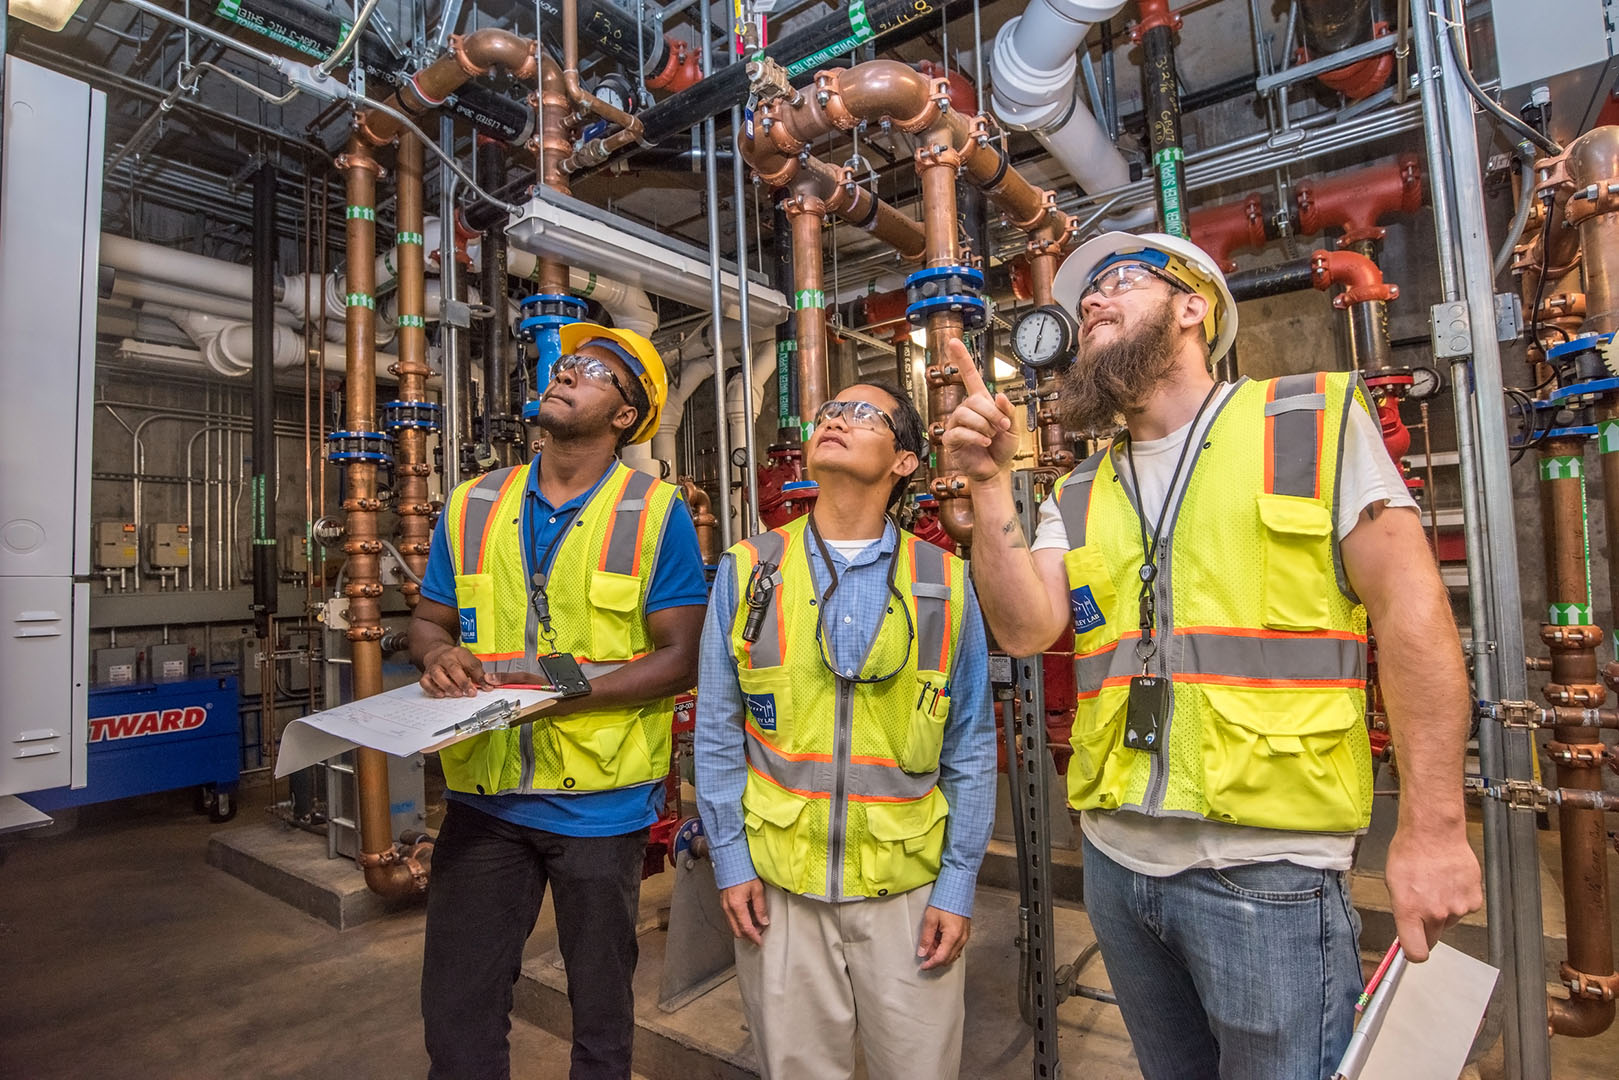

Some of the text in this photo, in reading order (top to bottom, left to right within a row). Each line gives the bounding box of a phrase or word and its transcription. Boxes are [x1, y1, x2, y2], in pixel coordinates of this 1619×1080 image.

[235, 16, 267, 35] TOWER
[268, 31, 298, 49] WATER
[804, 51, 832, 68] WATER
[829, 38, 859, 57] TOWER
[476, 113, 501, 129] LISTED
[1161, 161, 1181, 236] TOWER WATER SUPPLY
[779, 352, 789, 416] TOWER WATER SUPPLY
[1086, 614, 1100, 623] LAB
[88, 706, 207, 742] TWARD
